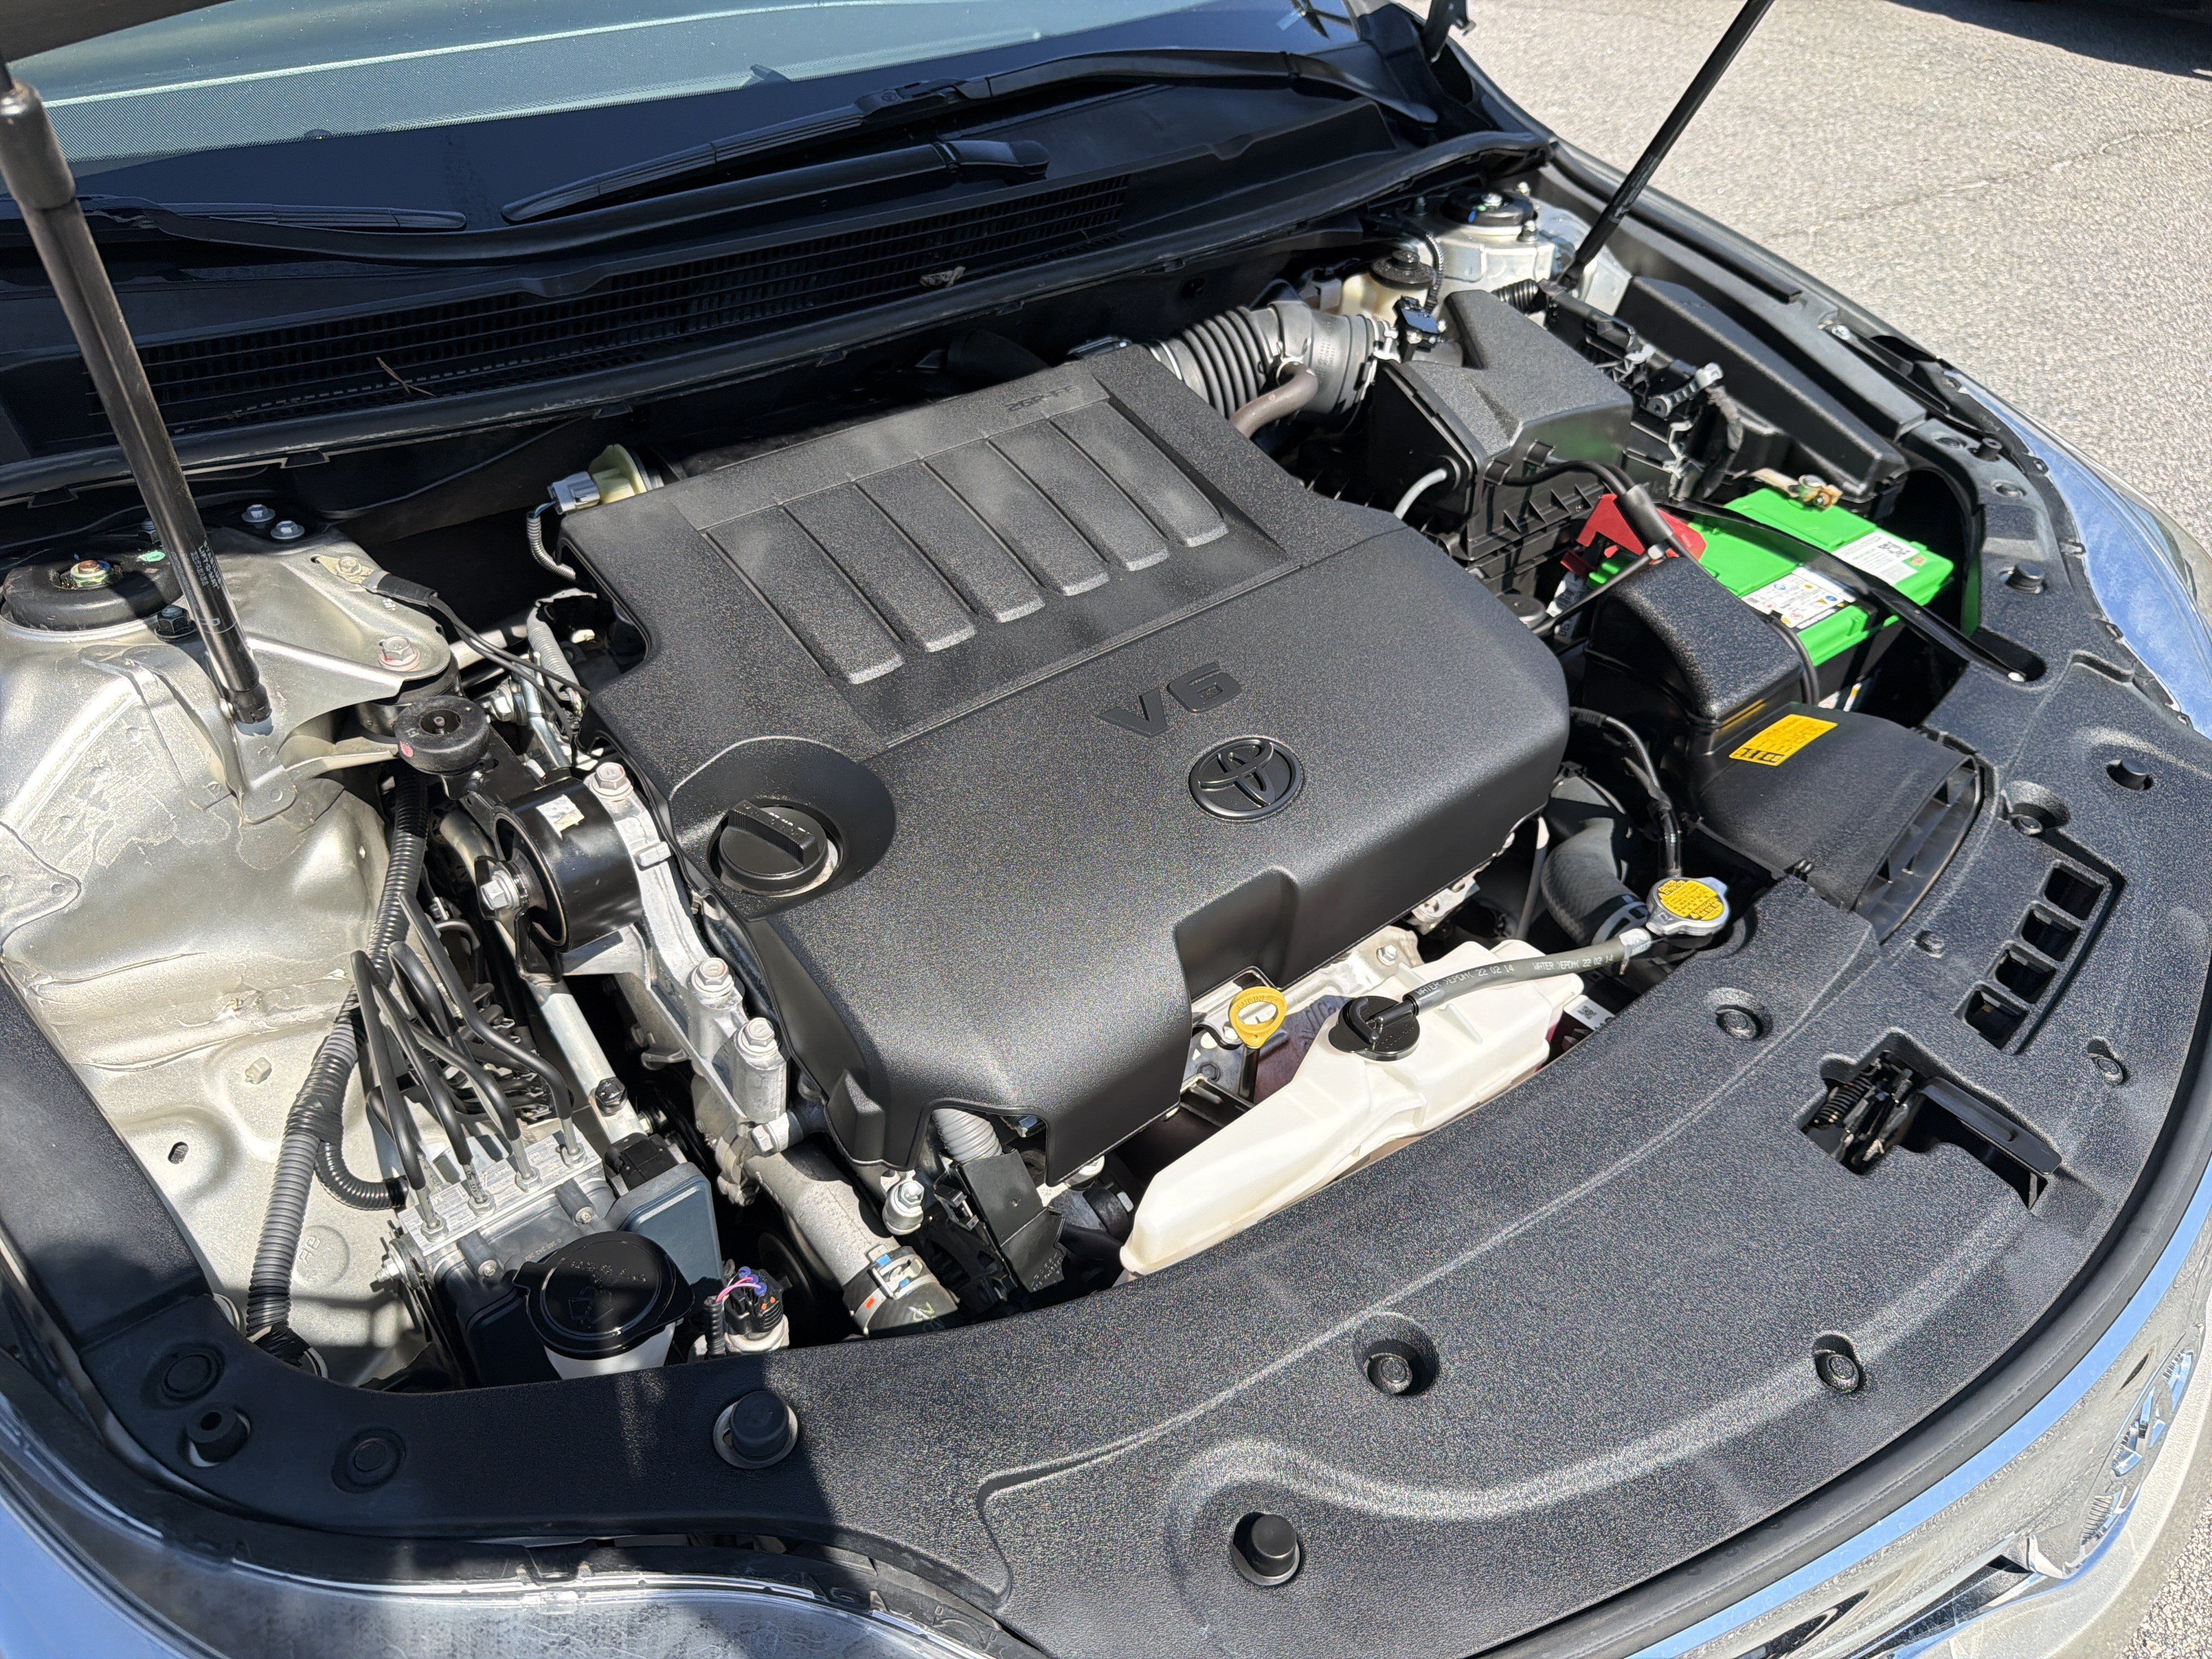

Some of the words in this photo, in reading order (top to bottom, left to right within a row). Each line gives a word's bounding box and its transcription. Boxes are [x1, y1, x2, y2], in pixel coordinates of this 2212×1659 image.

[1098, 662, 1242, 737] V6
[1532, 962, 1554, 970] WATER
[1582, 958, 1591, 967] 22
[1415, 982, 1442, 996] WATER
[1476, 968, 1488, 977] 22
[1489, 966, 1502, 974] 02
[1504, 964, 1514, 973] 14
[1237, 995, 1268, 1009] ENGINE
